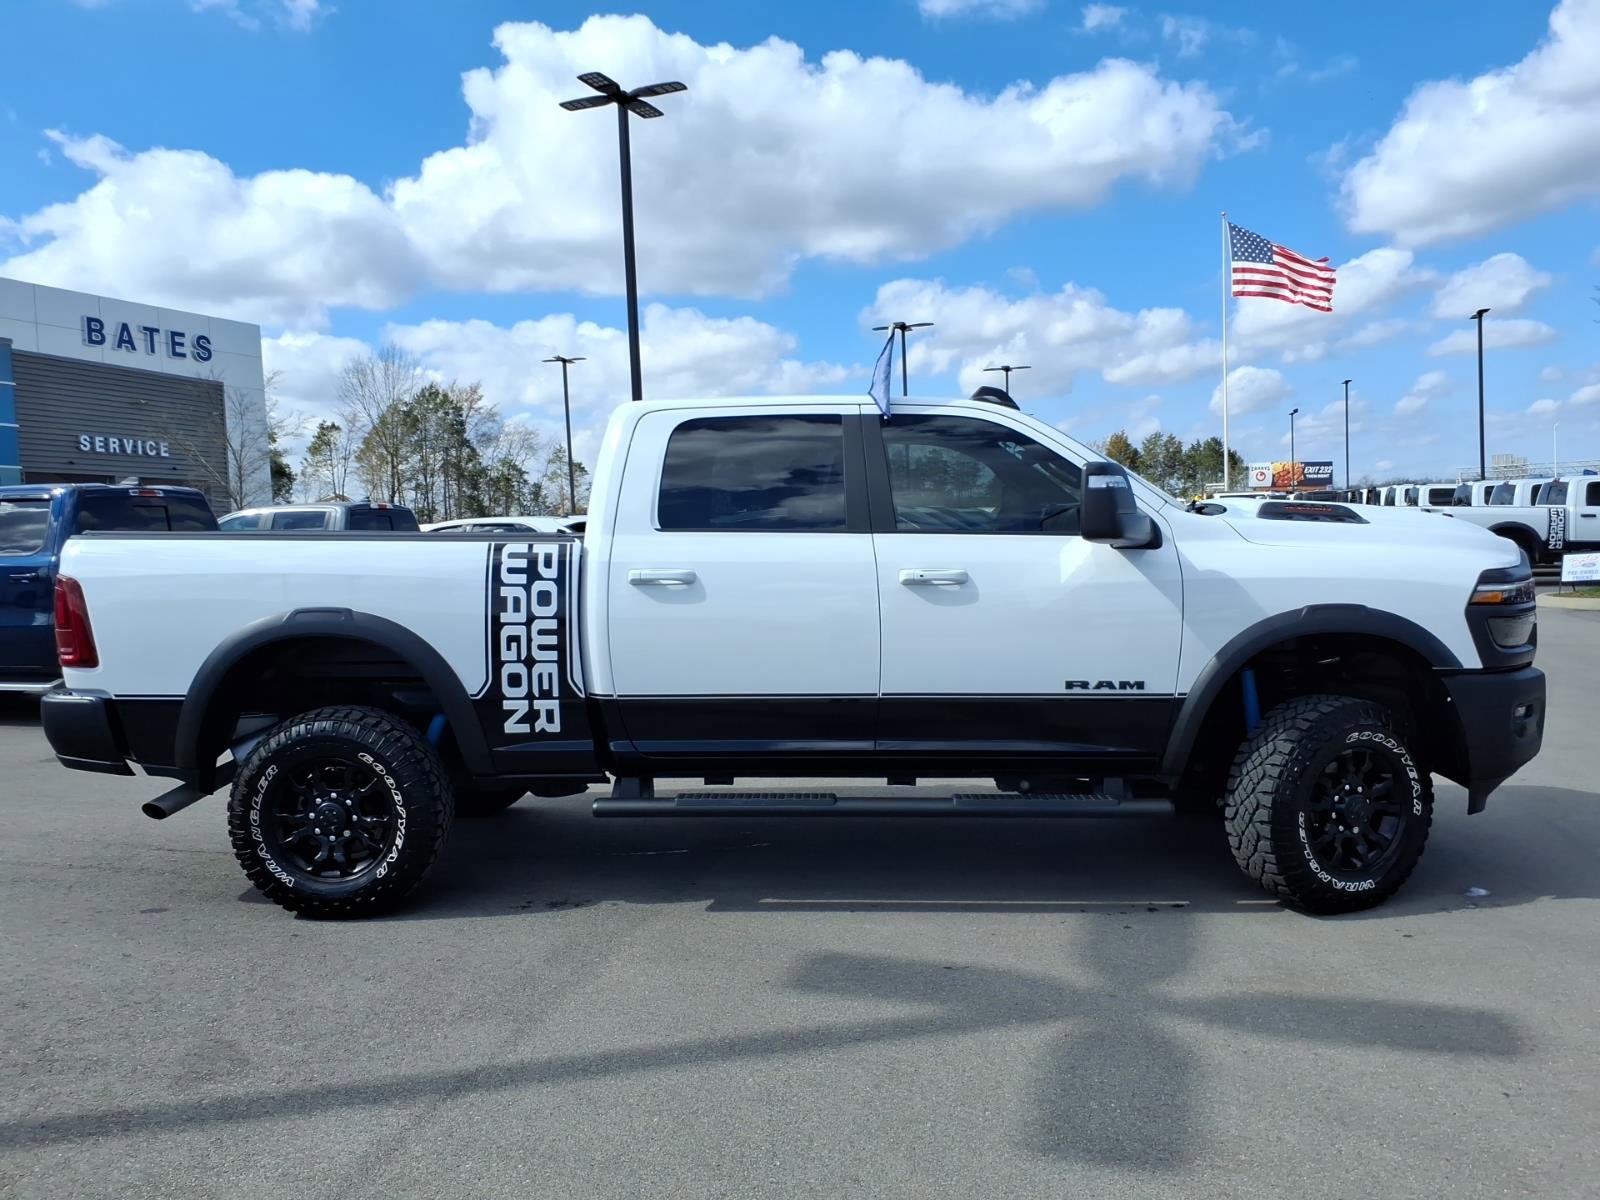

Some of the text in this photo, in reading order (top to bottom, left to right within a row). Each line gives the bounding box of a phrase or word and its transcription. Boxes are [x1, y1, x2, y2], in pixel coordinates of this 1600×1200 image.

[83, 315, 213, 363] BATES
[79, 434, 170, 457] SERVICE
[1304, 465, 1333, 474] EXIT 232
[1548, 508, 1558, 549] WAGON
[1556, 508, 1565, 549] POWER
[500, 544, 531, 734] WAGON
[531, 544, 561, 733] POWER
[1065, 680, 1145, 690] RAM
[1346, 731, 1422, 815] GOODYEAR
[250, 764, 295, 887] WRANGLER
[357, 752, 406, 878] GOODYEAR
[1298, 811, 1376, 892] WRANGLER
